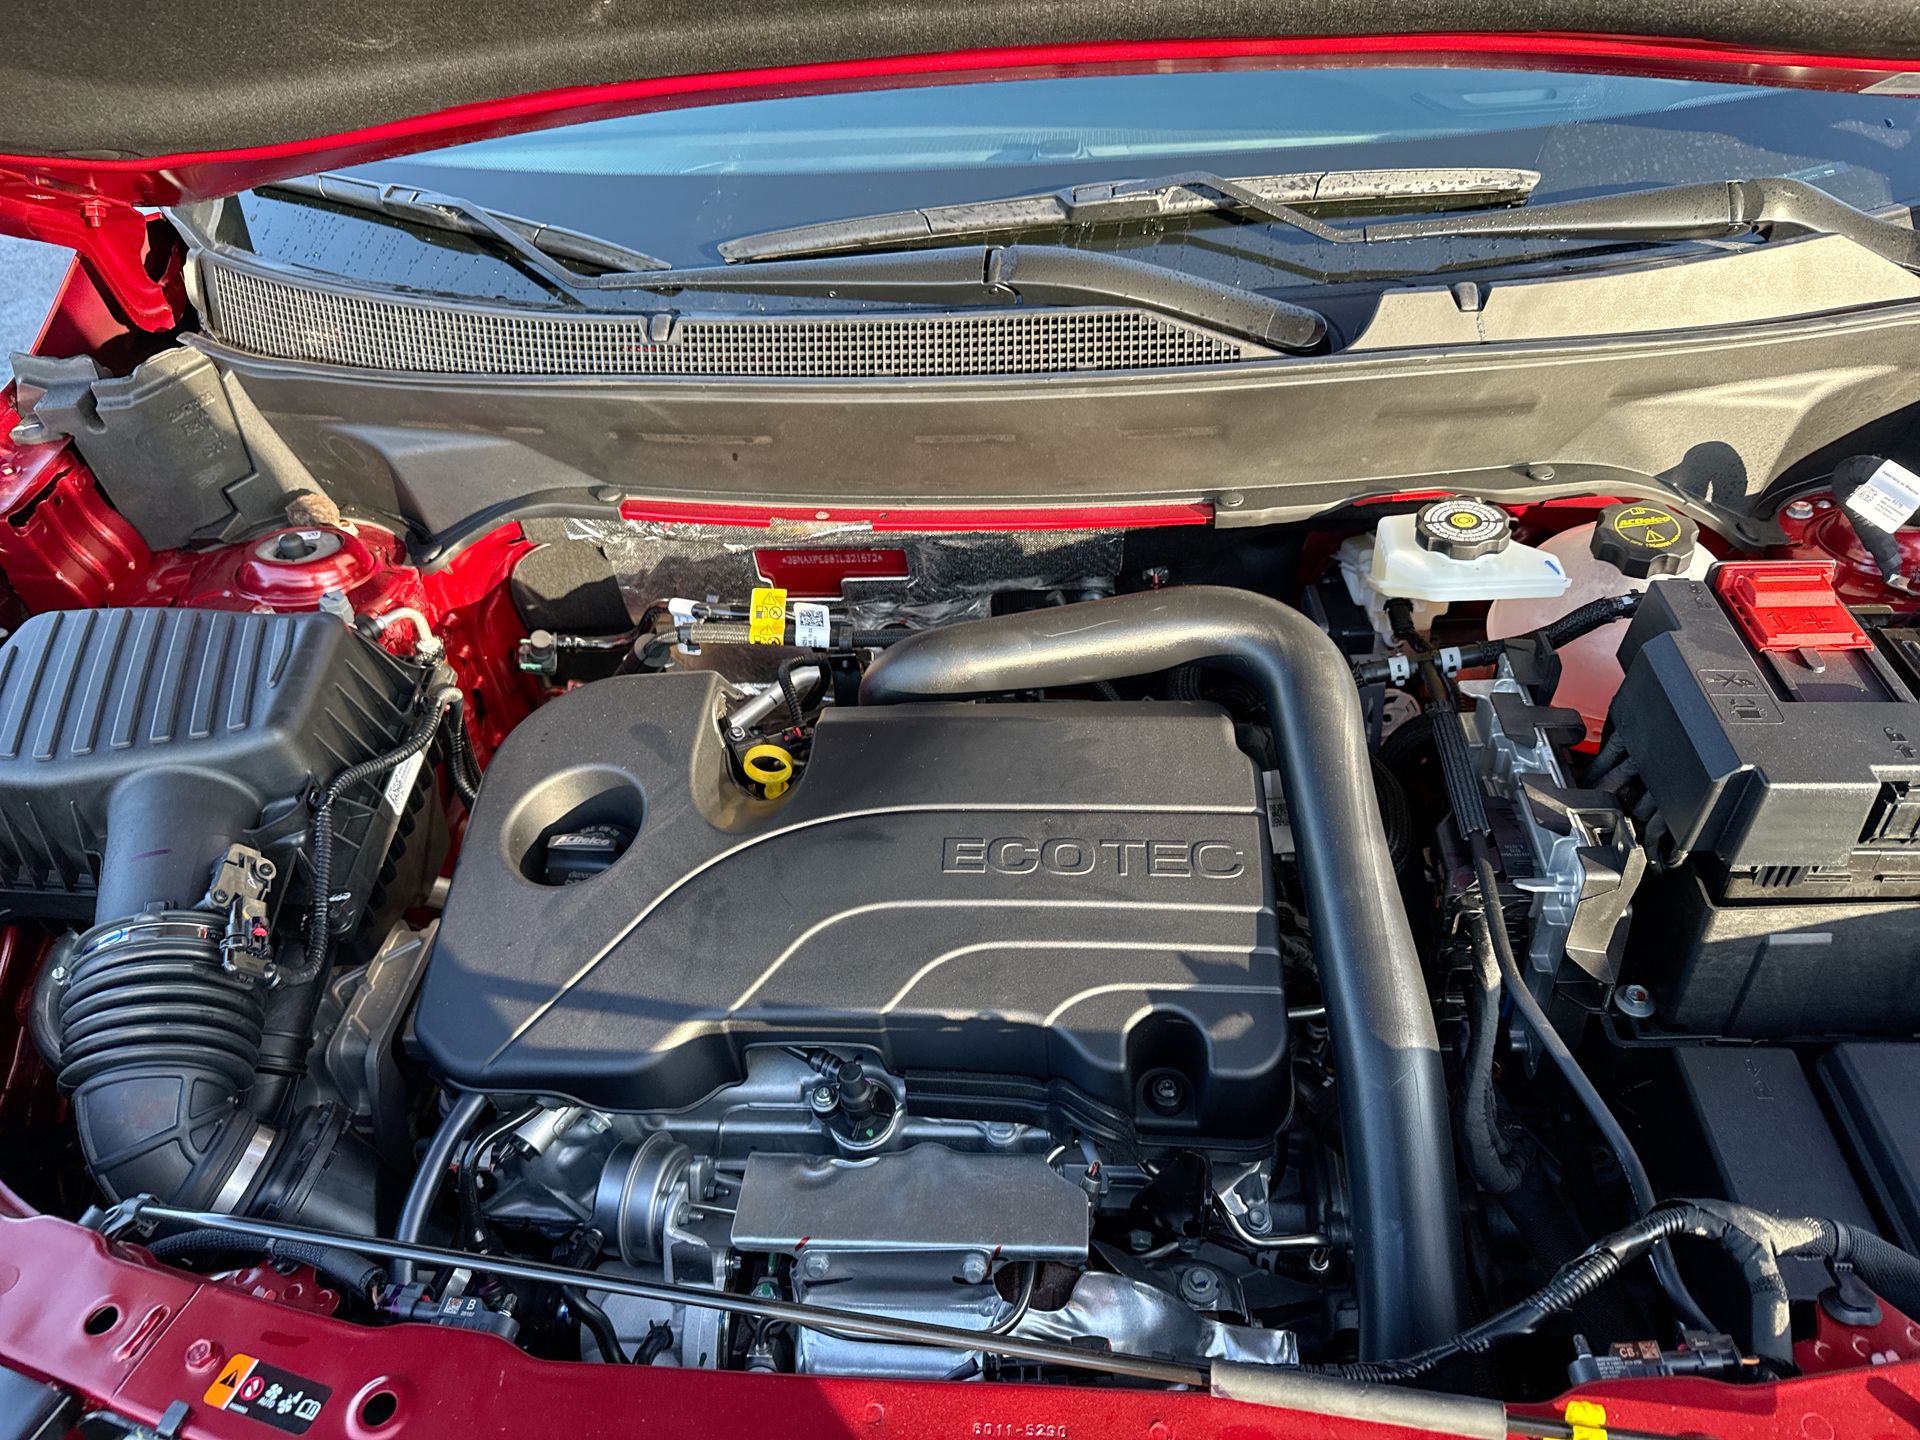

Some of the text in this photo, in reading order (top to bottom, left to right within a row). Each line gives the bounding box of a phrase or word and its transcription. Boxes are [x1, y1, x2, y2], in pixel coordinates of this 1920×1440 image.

[1619, 516, 1671, 527] ACDelco
[553, 835, 611, 846] ACDelco
[942, 836, 1245, 880] ECOTEC
[466, 1298, 477, 1311] B
